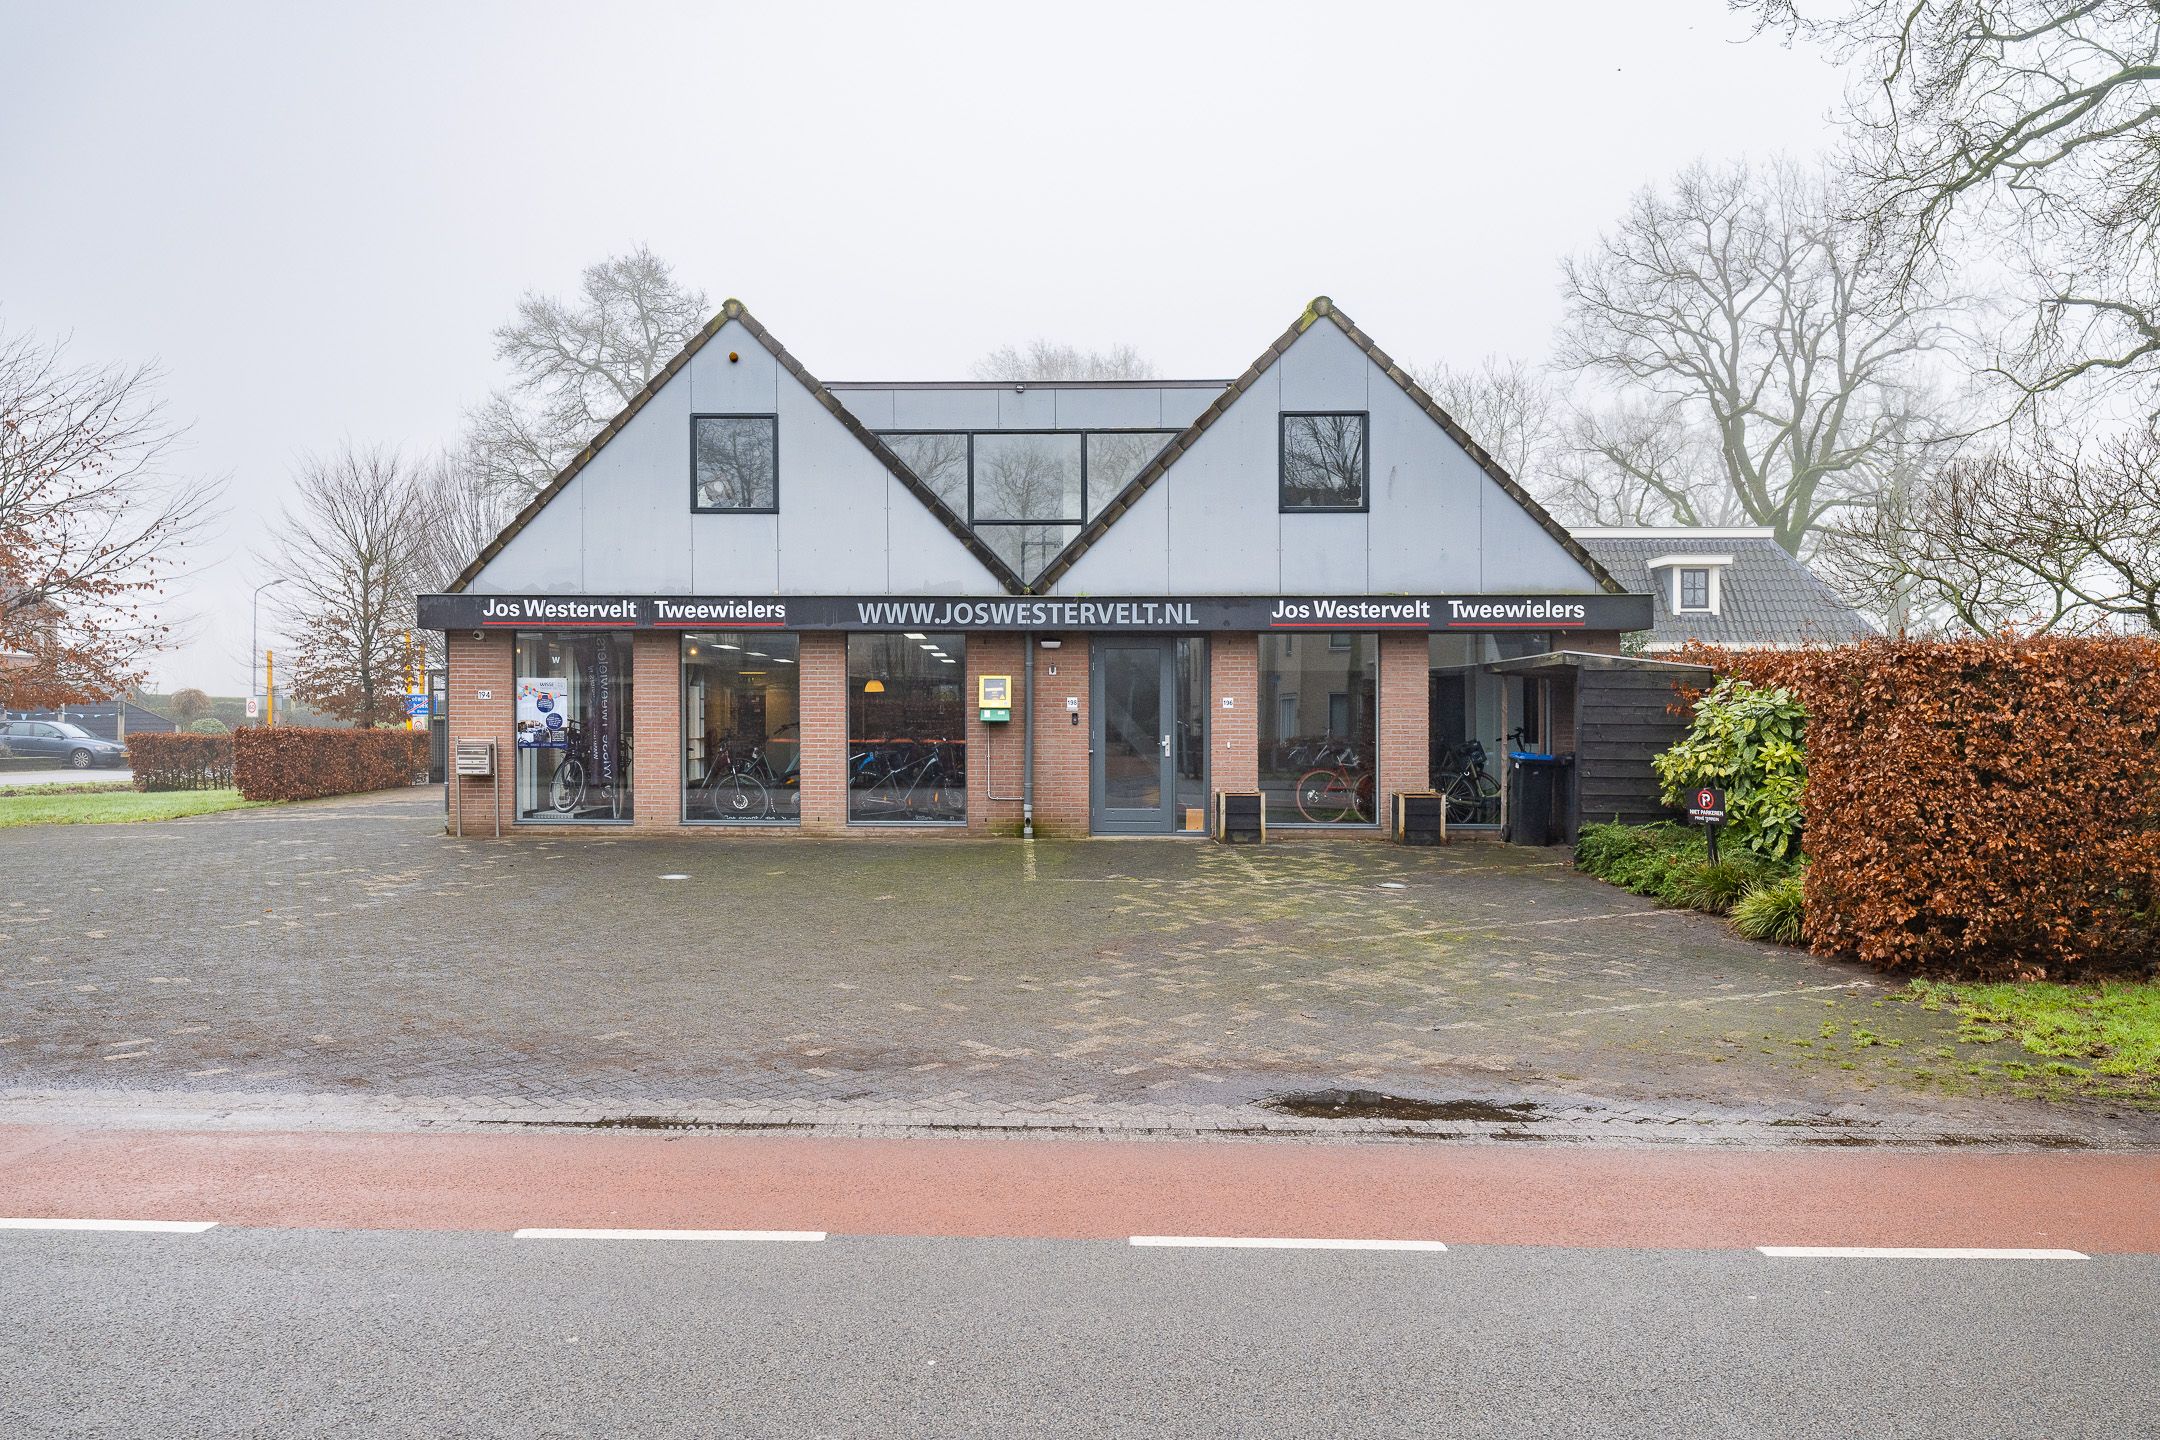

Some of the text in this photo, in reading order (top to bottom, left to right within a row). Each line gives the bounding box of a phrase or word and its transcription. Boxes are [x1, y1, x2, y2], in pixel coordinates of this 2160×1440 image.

[482, 599, 637, 618] Jos Westervelt
[654, 600, 786, 618] Tweewielers
[857, 602, 1199, 625] WWW.JOSWESTERVELT.NL
[1271, 599, 1430, 618] Jos Westervelt
[1447, 600, 1586, 618] Tweewielers
